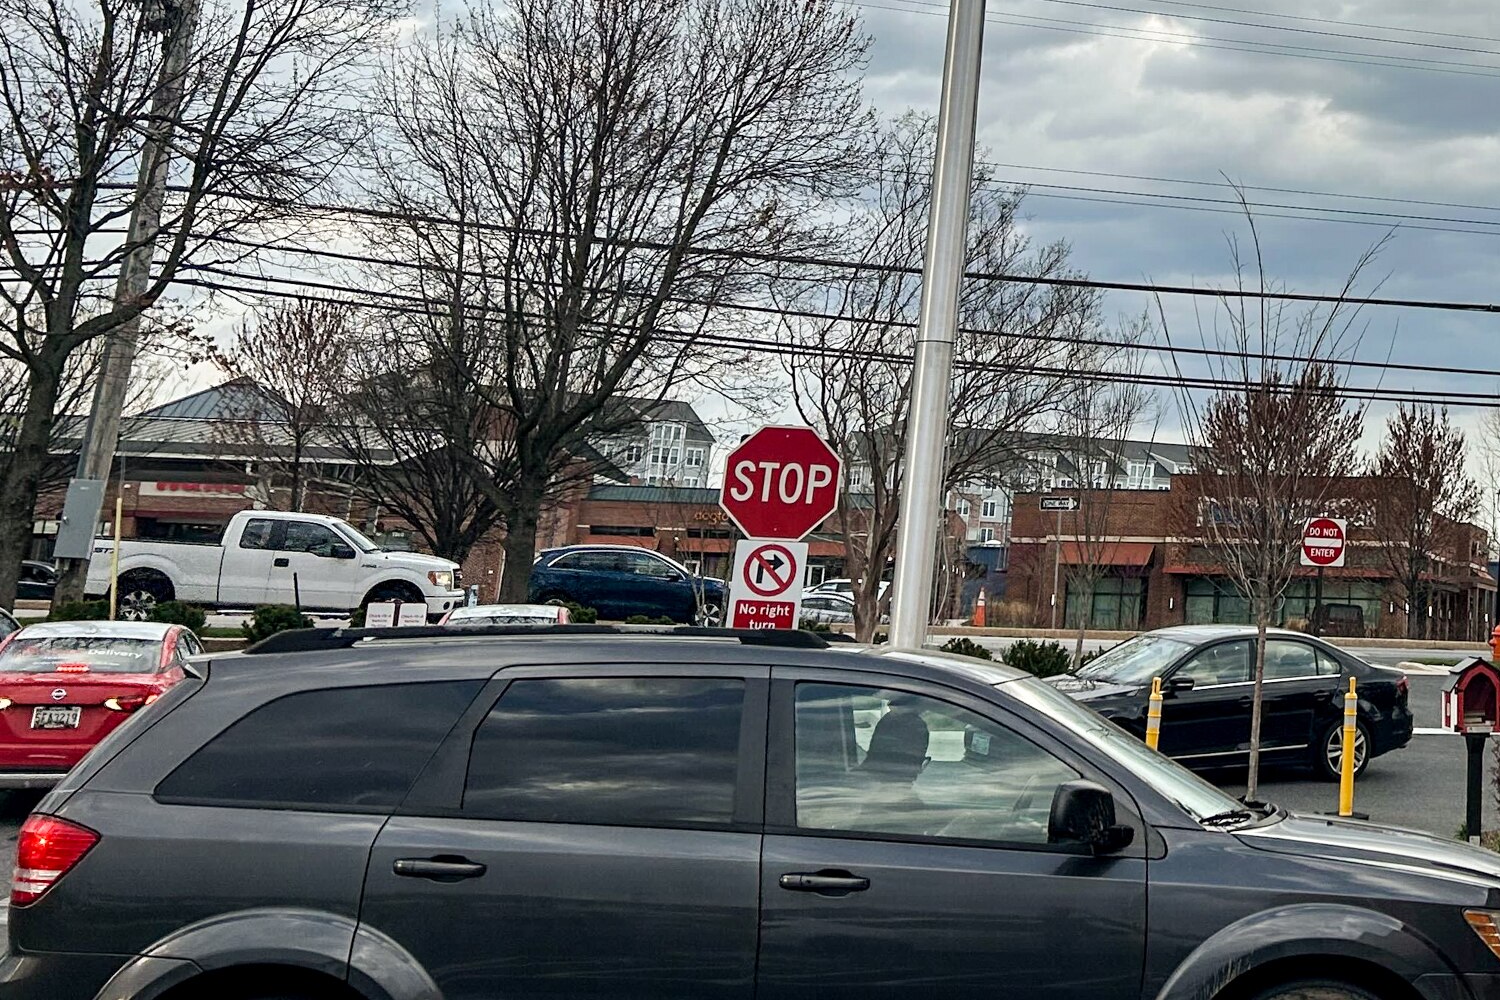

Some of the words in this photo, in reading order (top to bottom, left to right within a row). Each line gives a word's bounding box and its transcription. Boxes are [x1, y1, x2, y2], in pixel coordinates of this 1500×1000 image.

[730, 460, 833, 505] STOP
[1310, 527, 1320, 536] DO
[1322, 528, 1338, 537] NOT
[1310, 548, 1335, 557] ENTER
[739, 603, 757, 616] No
[759, 603, 790, 619] right
[749, 619, 776, 630] turn
[88, 648, 142, 659] Delivery
